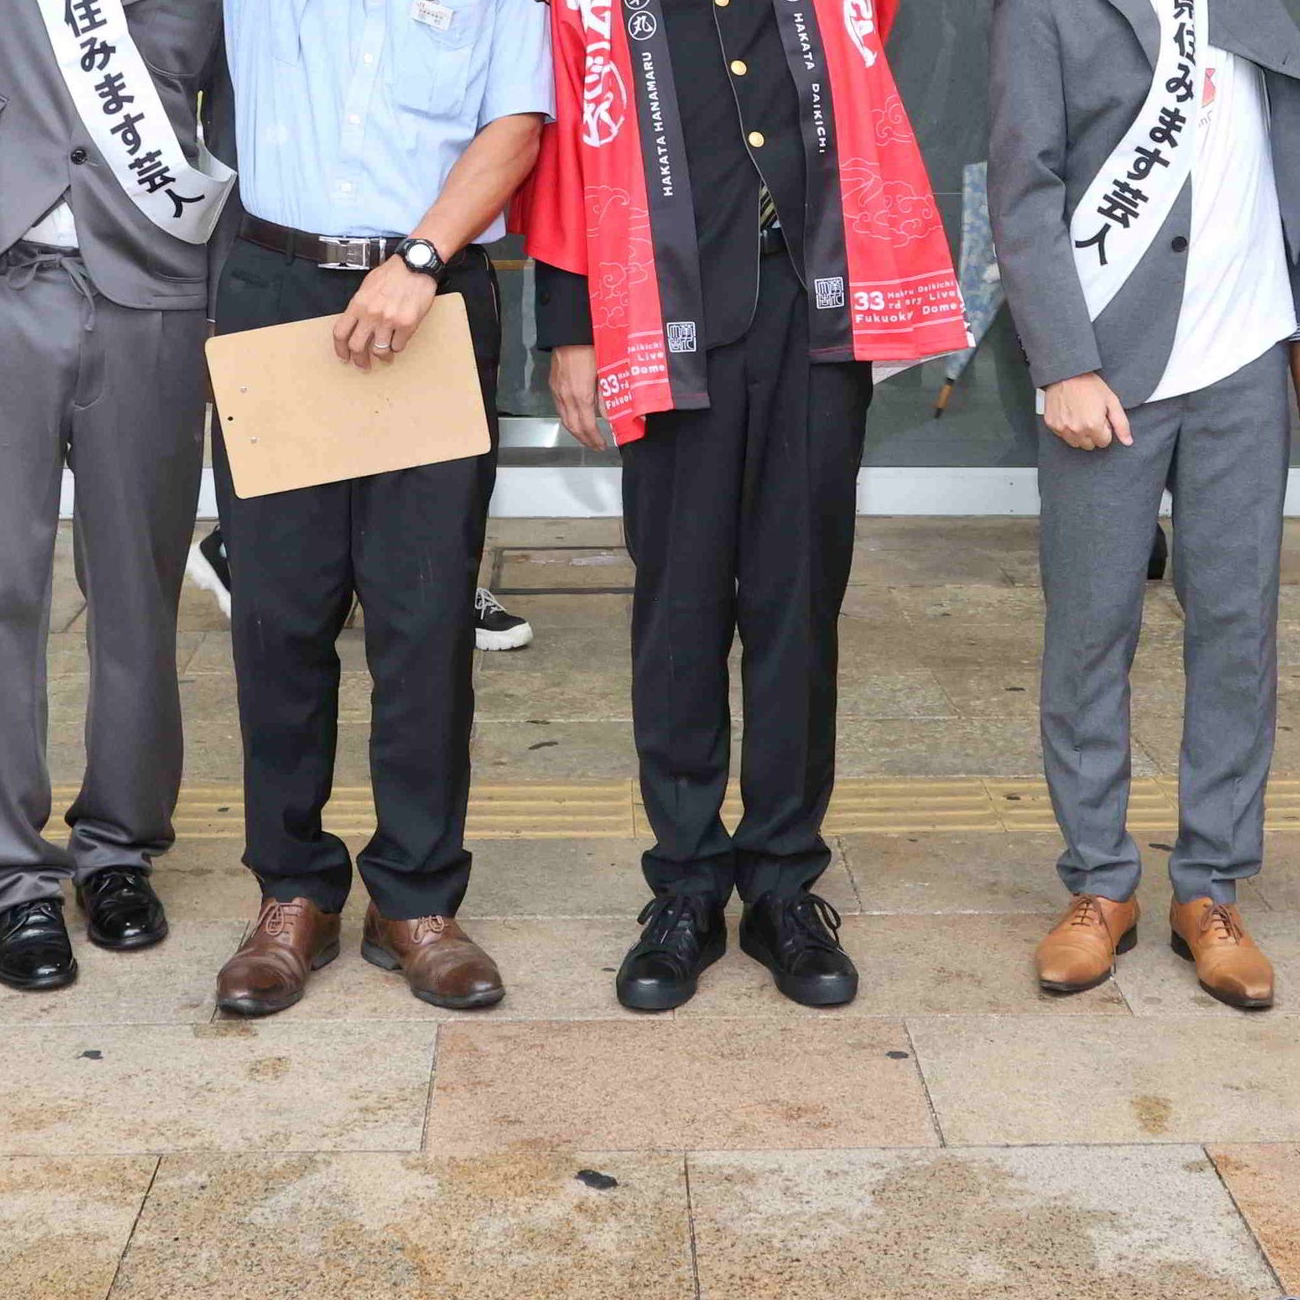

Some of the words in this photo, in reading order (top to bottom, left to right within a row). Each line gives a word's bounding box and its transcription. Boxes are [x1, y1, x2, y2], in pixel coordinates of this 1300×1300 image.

[641, 51, 665, 132] HANAMARU
[793, 12, 816, 71] HAKATA
[811, 82, 825, 154] DAIKICHI
[656, 135, 674, 197] HAKATA
[922, 302, 957, 315] Dome
